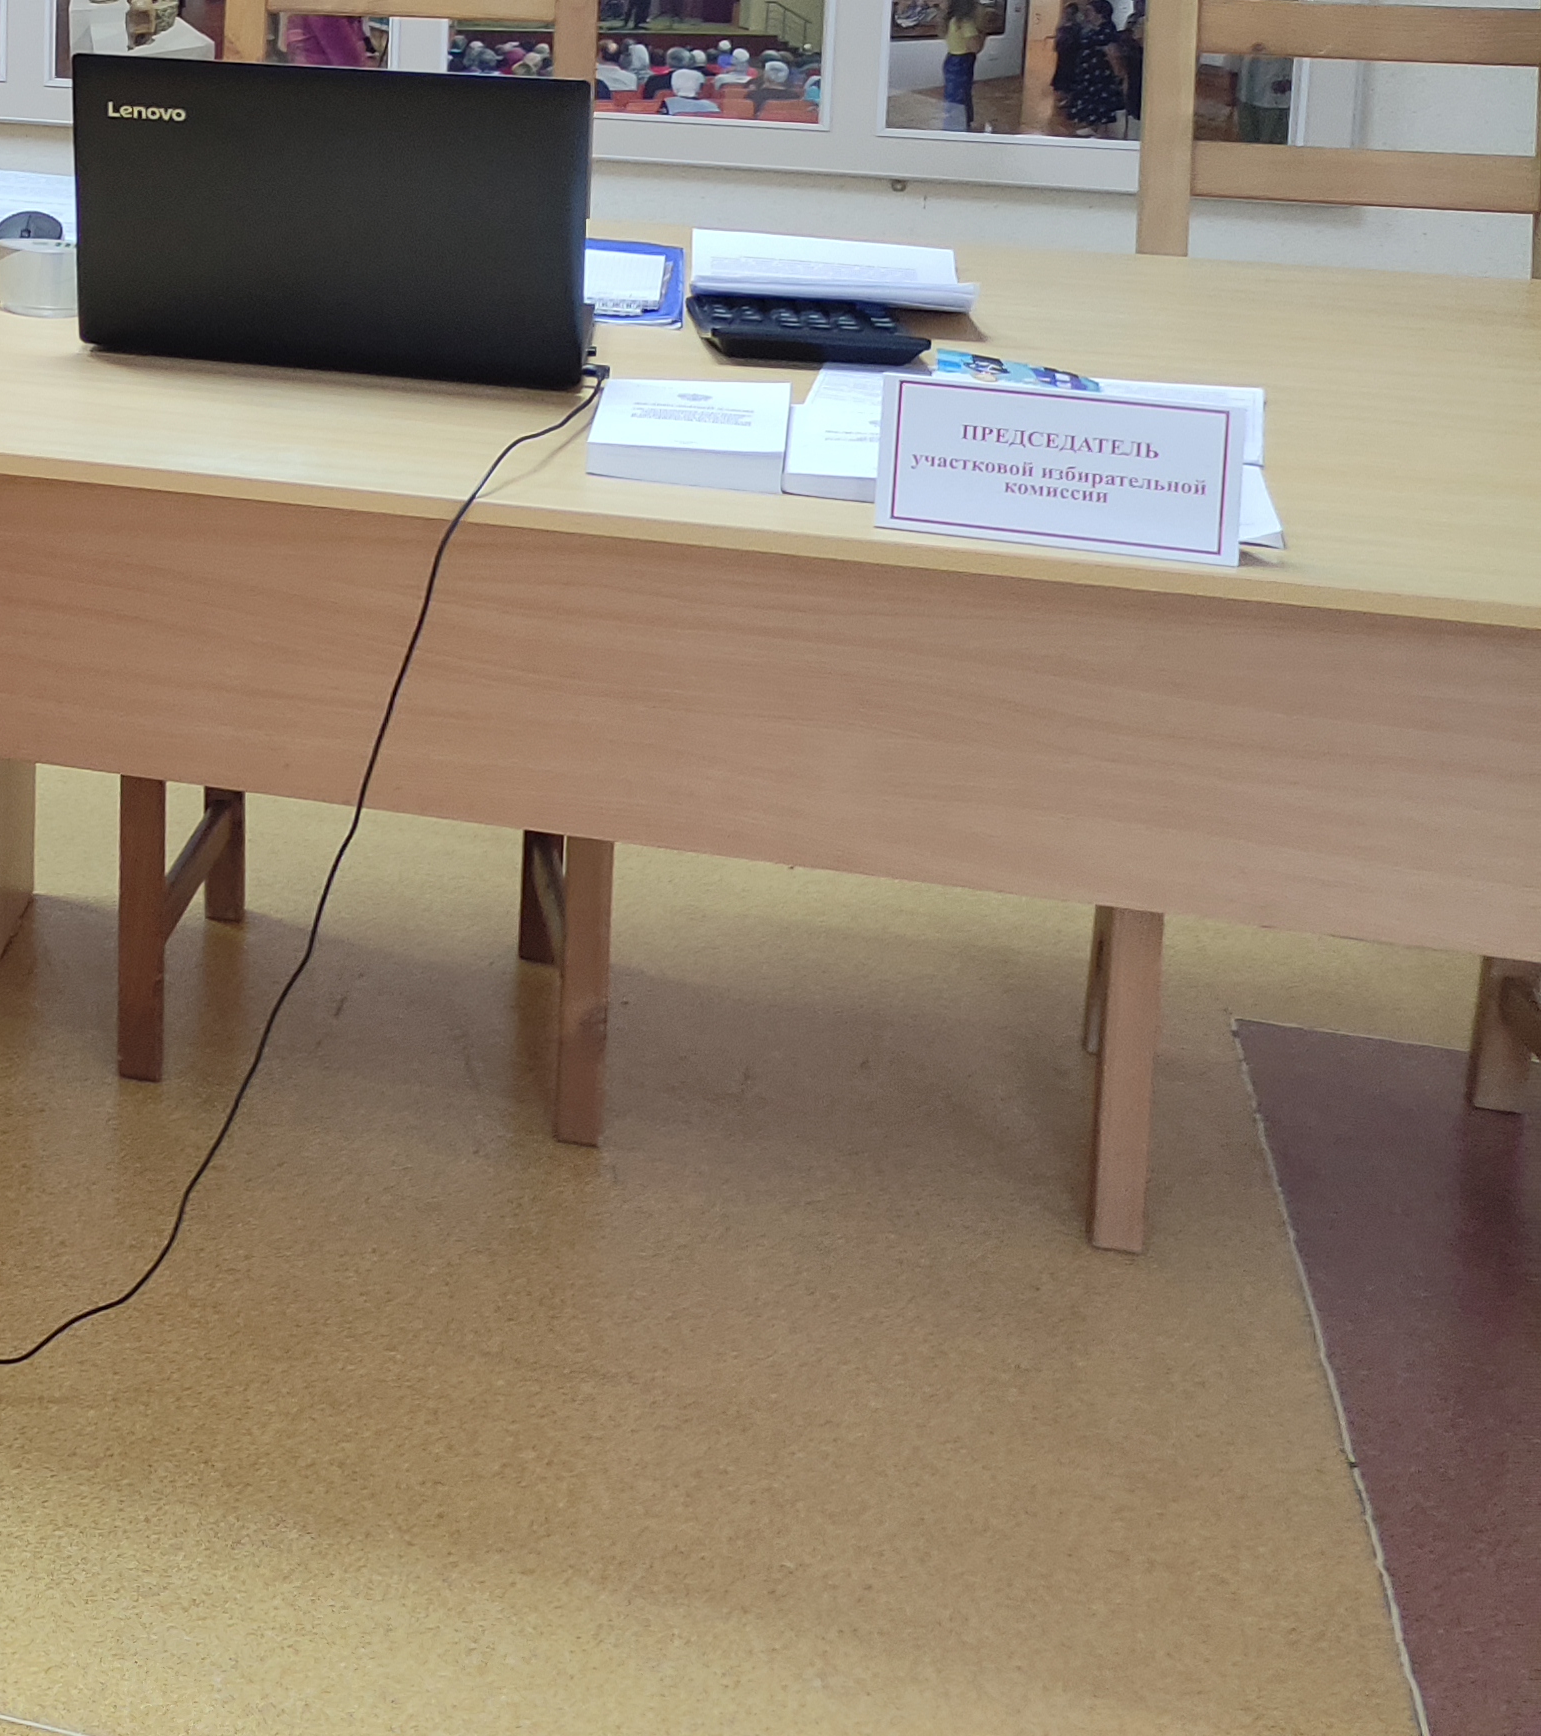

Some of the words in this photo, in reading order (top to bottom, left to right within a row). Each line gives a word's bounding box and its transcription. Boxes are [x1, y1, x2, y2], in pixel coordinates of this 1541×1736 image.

[107, 100, 187, 122] Lenovo
[961, 424, 1160, 460] ПРЕДСЕДАТЕЛЬ
[910, 452, 1035, 478] участковой
[1040, 466, 1208, 497] избирательной
[1003, 479, 1110, 504] комиссии
